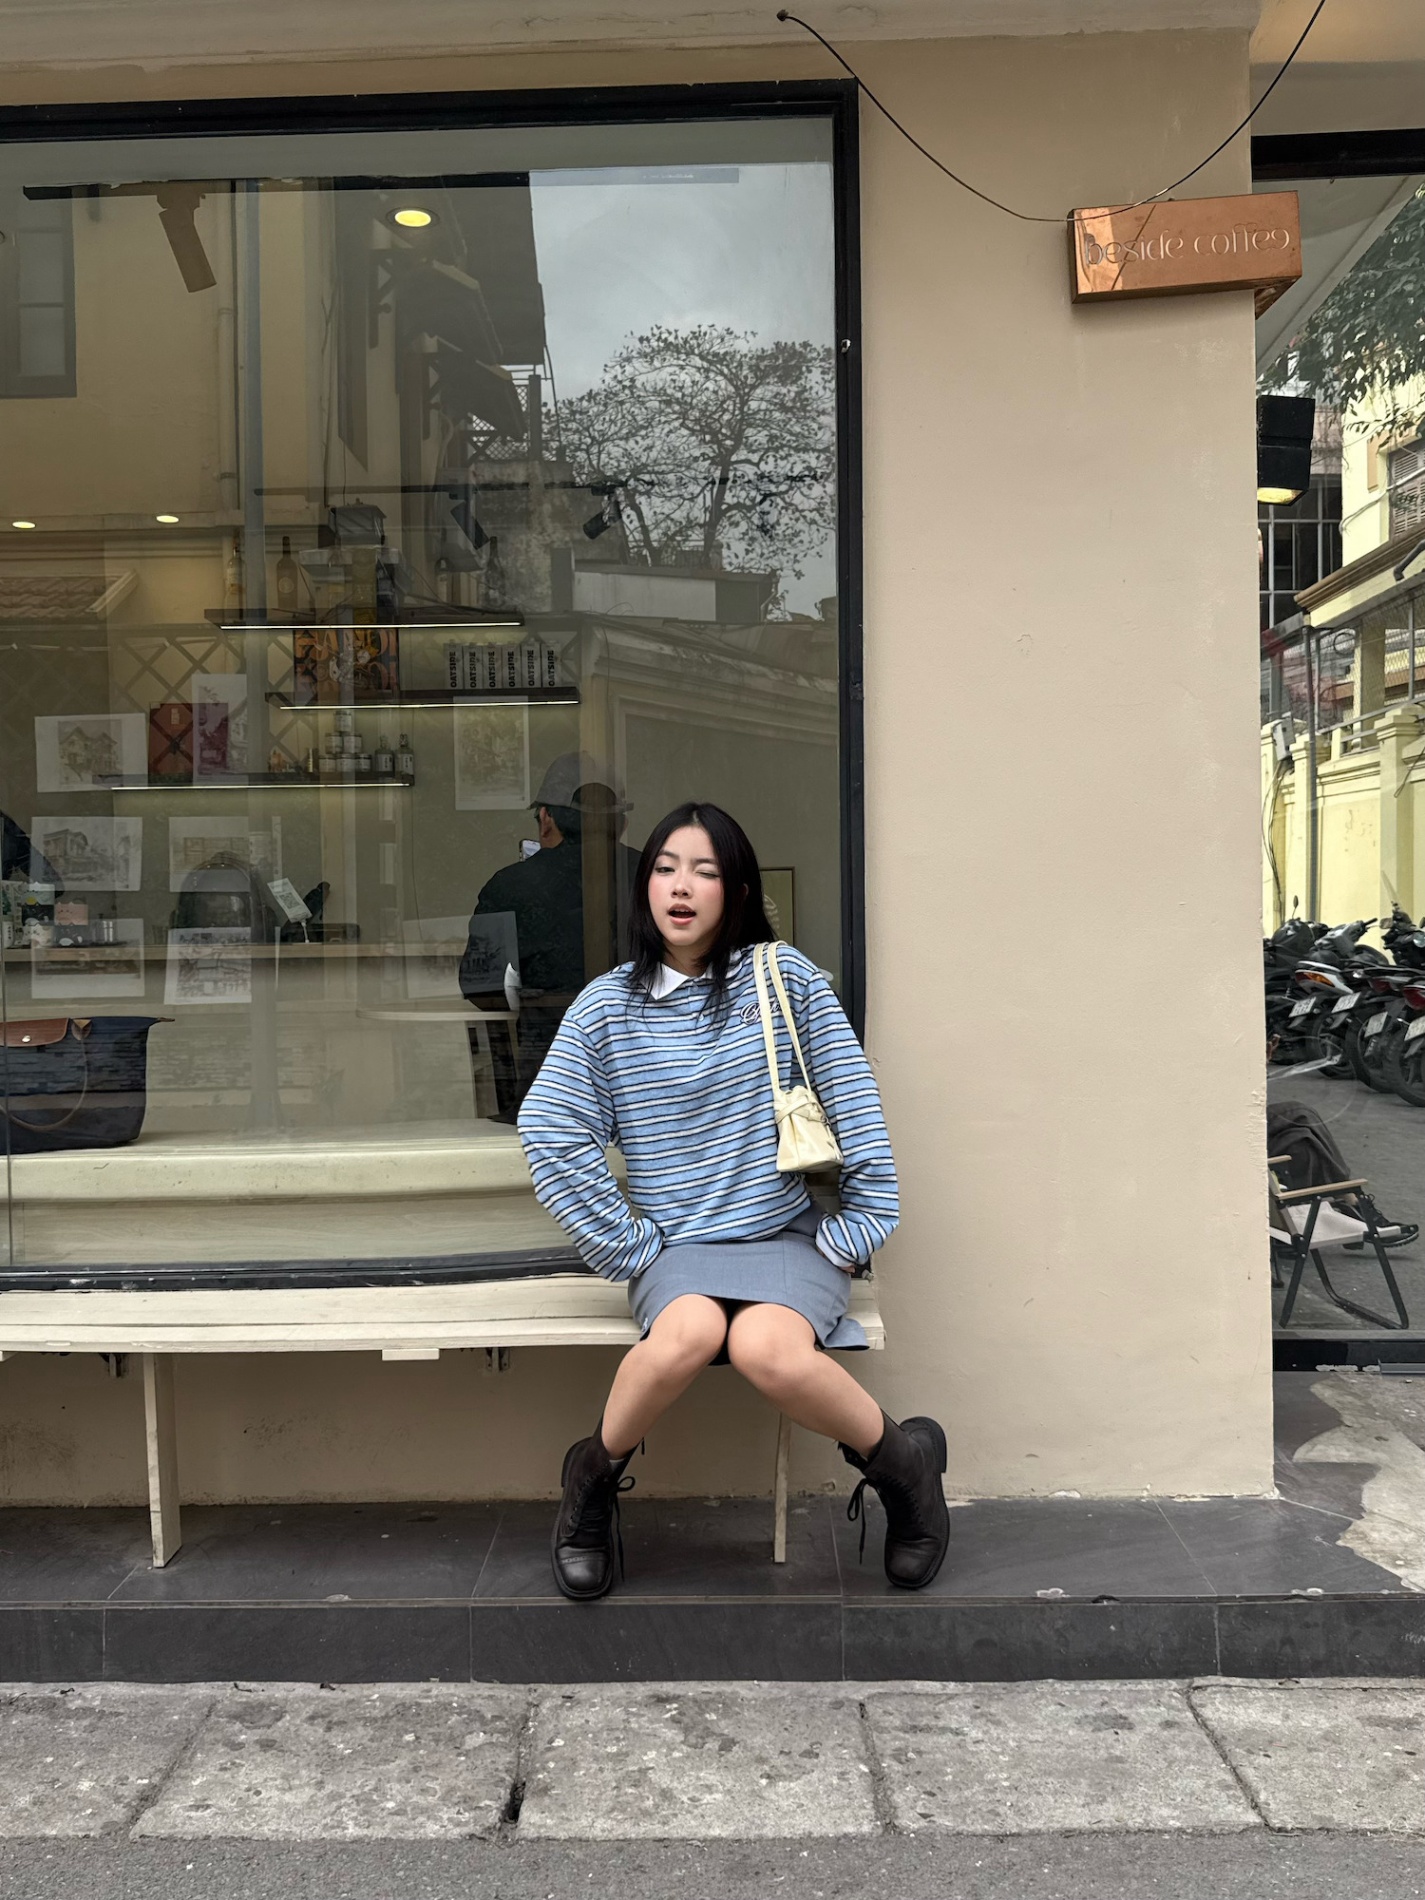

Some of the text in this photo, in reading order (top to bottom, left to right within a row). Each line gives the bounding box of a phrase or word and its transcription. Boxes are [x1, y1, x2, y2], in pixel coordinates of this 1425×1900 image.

[1084, 222, 1291, 266] beside coffee
[449, 651, 457, 688] OATSIDE
[469, 651, 477, 688] OATSIDE
[488, 650, 496, 688] OATSIDE
[507, 650, 515, 687] OATSIDE
[527, 649, 535, 687] OATSIDE
[547, 649, 555, 687] OATSIDE
